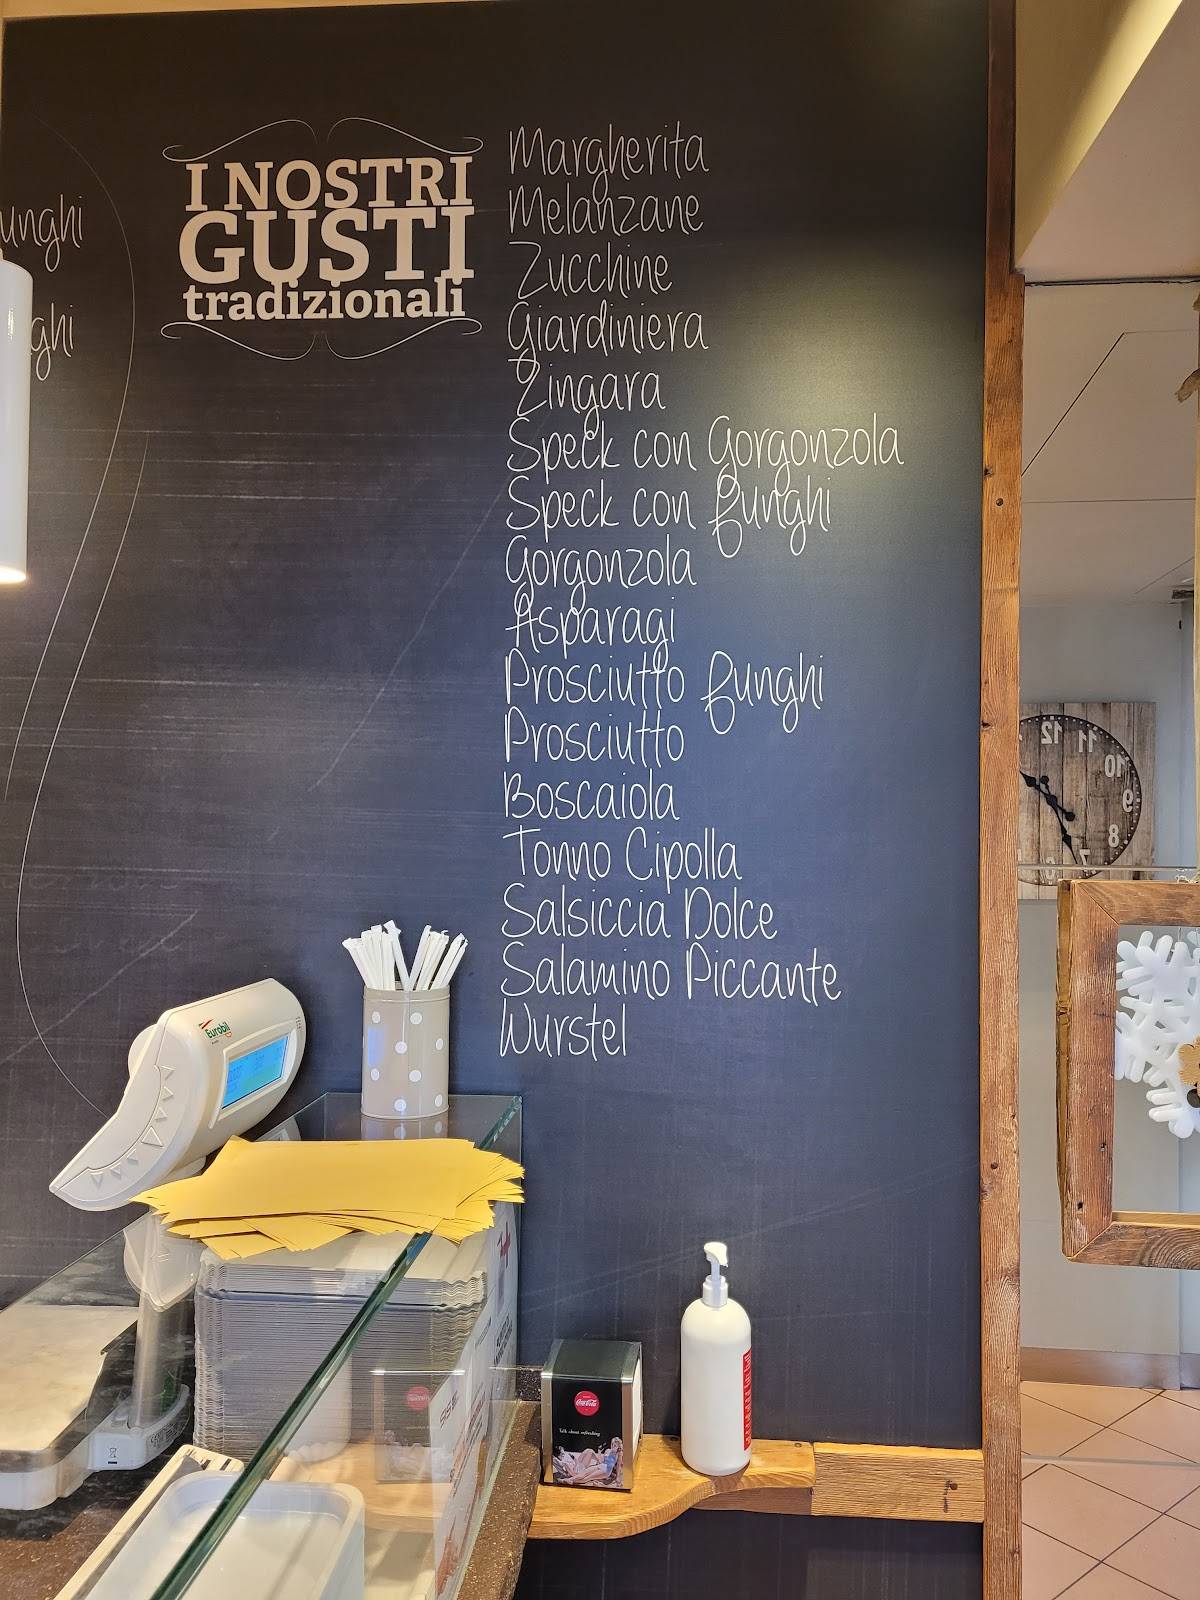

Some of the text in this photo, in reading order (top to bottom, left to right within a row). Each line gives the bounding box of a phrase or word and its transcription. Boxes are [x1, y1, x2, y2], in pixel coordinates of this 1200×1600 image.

[185, 156, 473, 212] I NOSTRI
[509, 120, 709, 204] Margherita
[0, 194, 83, 273] unghi
[179, 206, 475, 284] GUSTI
[509, 182, 704, 236] Melanzane
[183, 276, 465, 320] tradizionali
[509, 241, 672, 300] Zucchine
[31, 302, 74, 381] ghi
[508, 299, 709, 384] Giardiniera
[507, 358, 666, 440] Zingara
[506, 412, 904, 499] Speck con Gorgonzola
[506, 474, 831, 557] Speck con funghi
[505, 533, 697, 616] Gorgonzola
[505, 592, 675, 673] Asparagi
[504, 647, 824, 734] Prosciutto funghi
[504, 706, 684, 767] Prosciutto
[503, 768, 680, 821] Boscaiola
[502, 825, 742, 894] Tonno Cipolla
[501, 882, 777, 940] Salsiccia Dolce
[500, 941, 842, 1007] Salamino Piccante
[204, 1021, 231, 1039] Eurobil
[499, 998, 627, 1061] Wurstel
